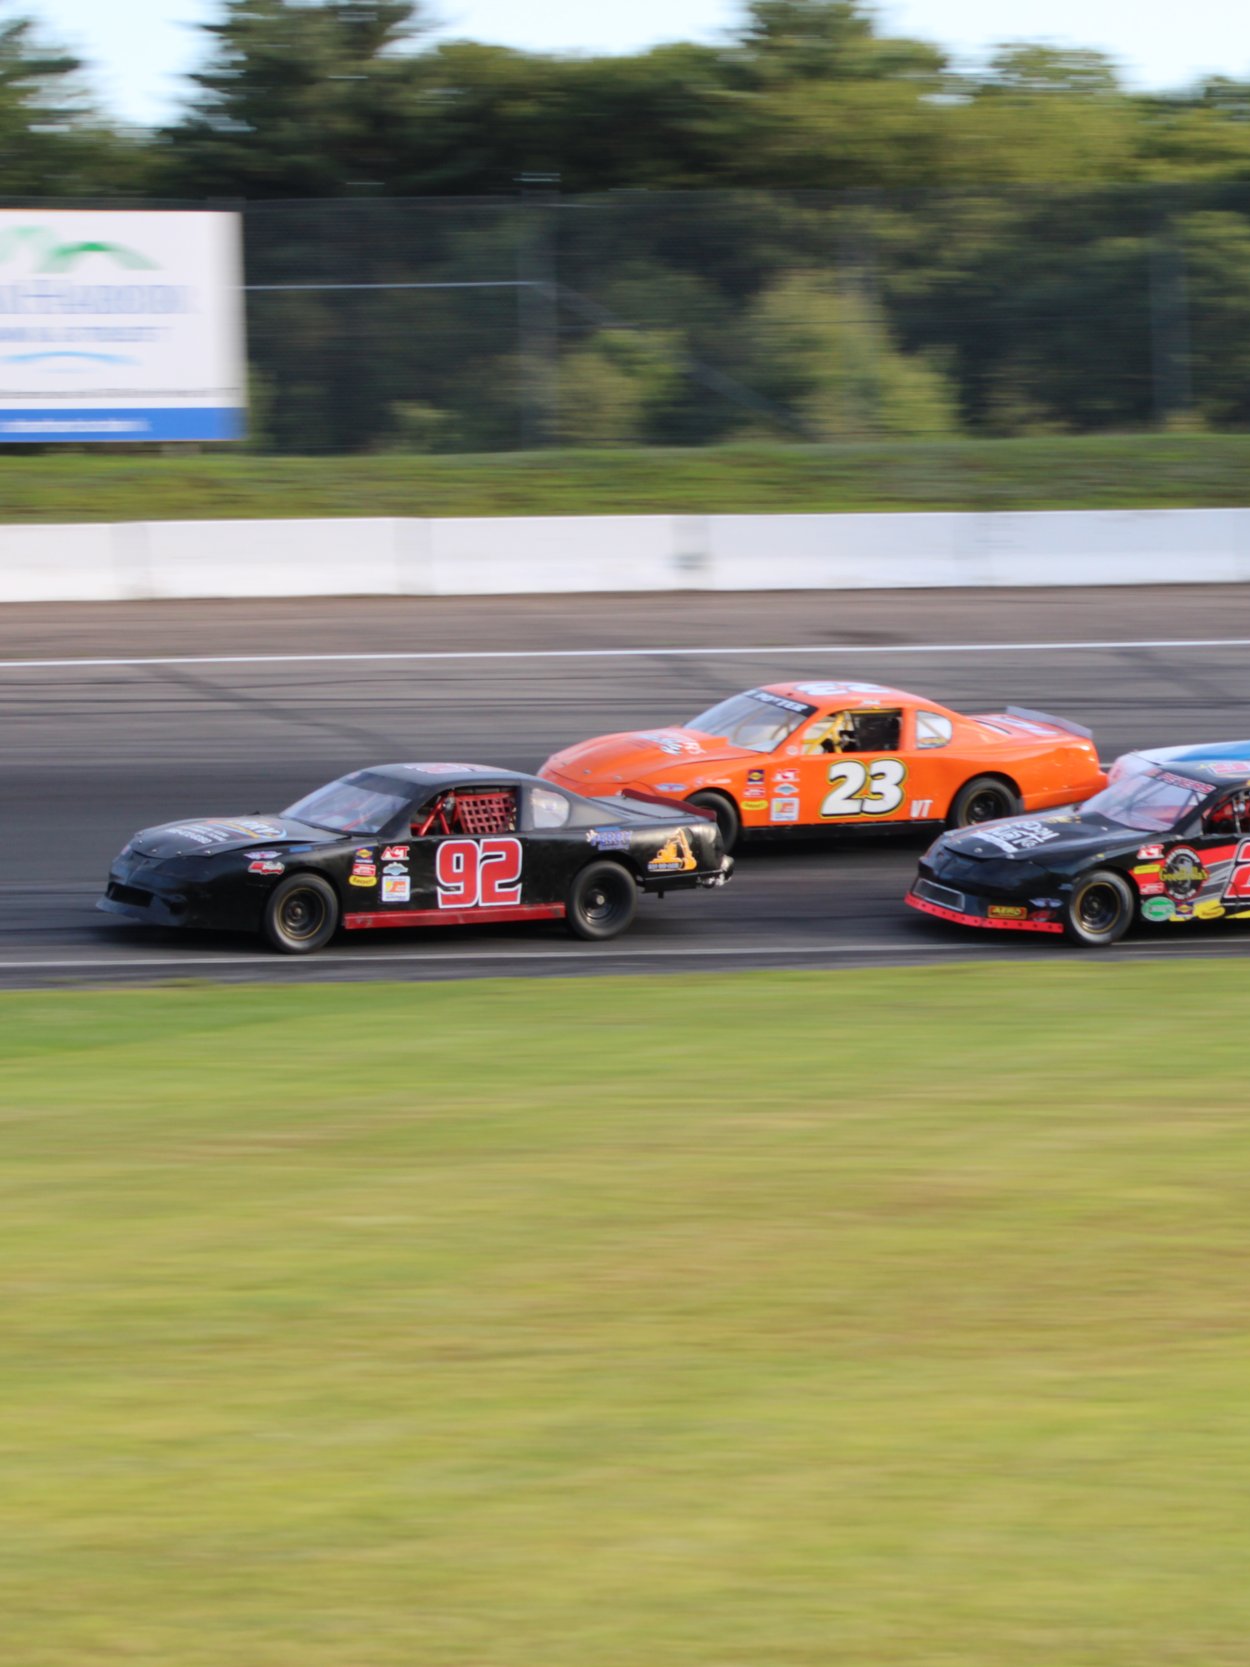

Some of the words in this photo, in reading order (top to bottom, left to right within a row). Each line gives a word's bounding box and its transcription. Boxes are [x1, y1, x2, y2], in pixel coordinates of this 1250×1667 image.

[819, 757, 907, 818] 23
[381, 845, 410, 861] ACT
[436, 837, 523, 909] 92
